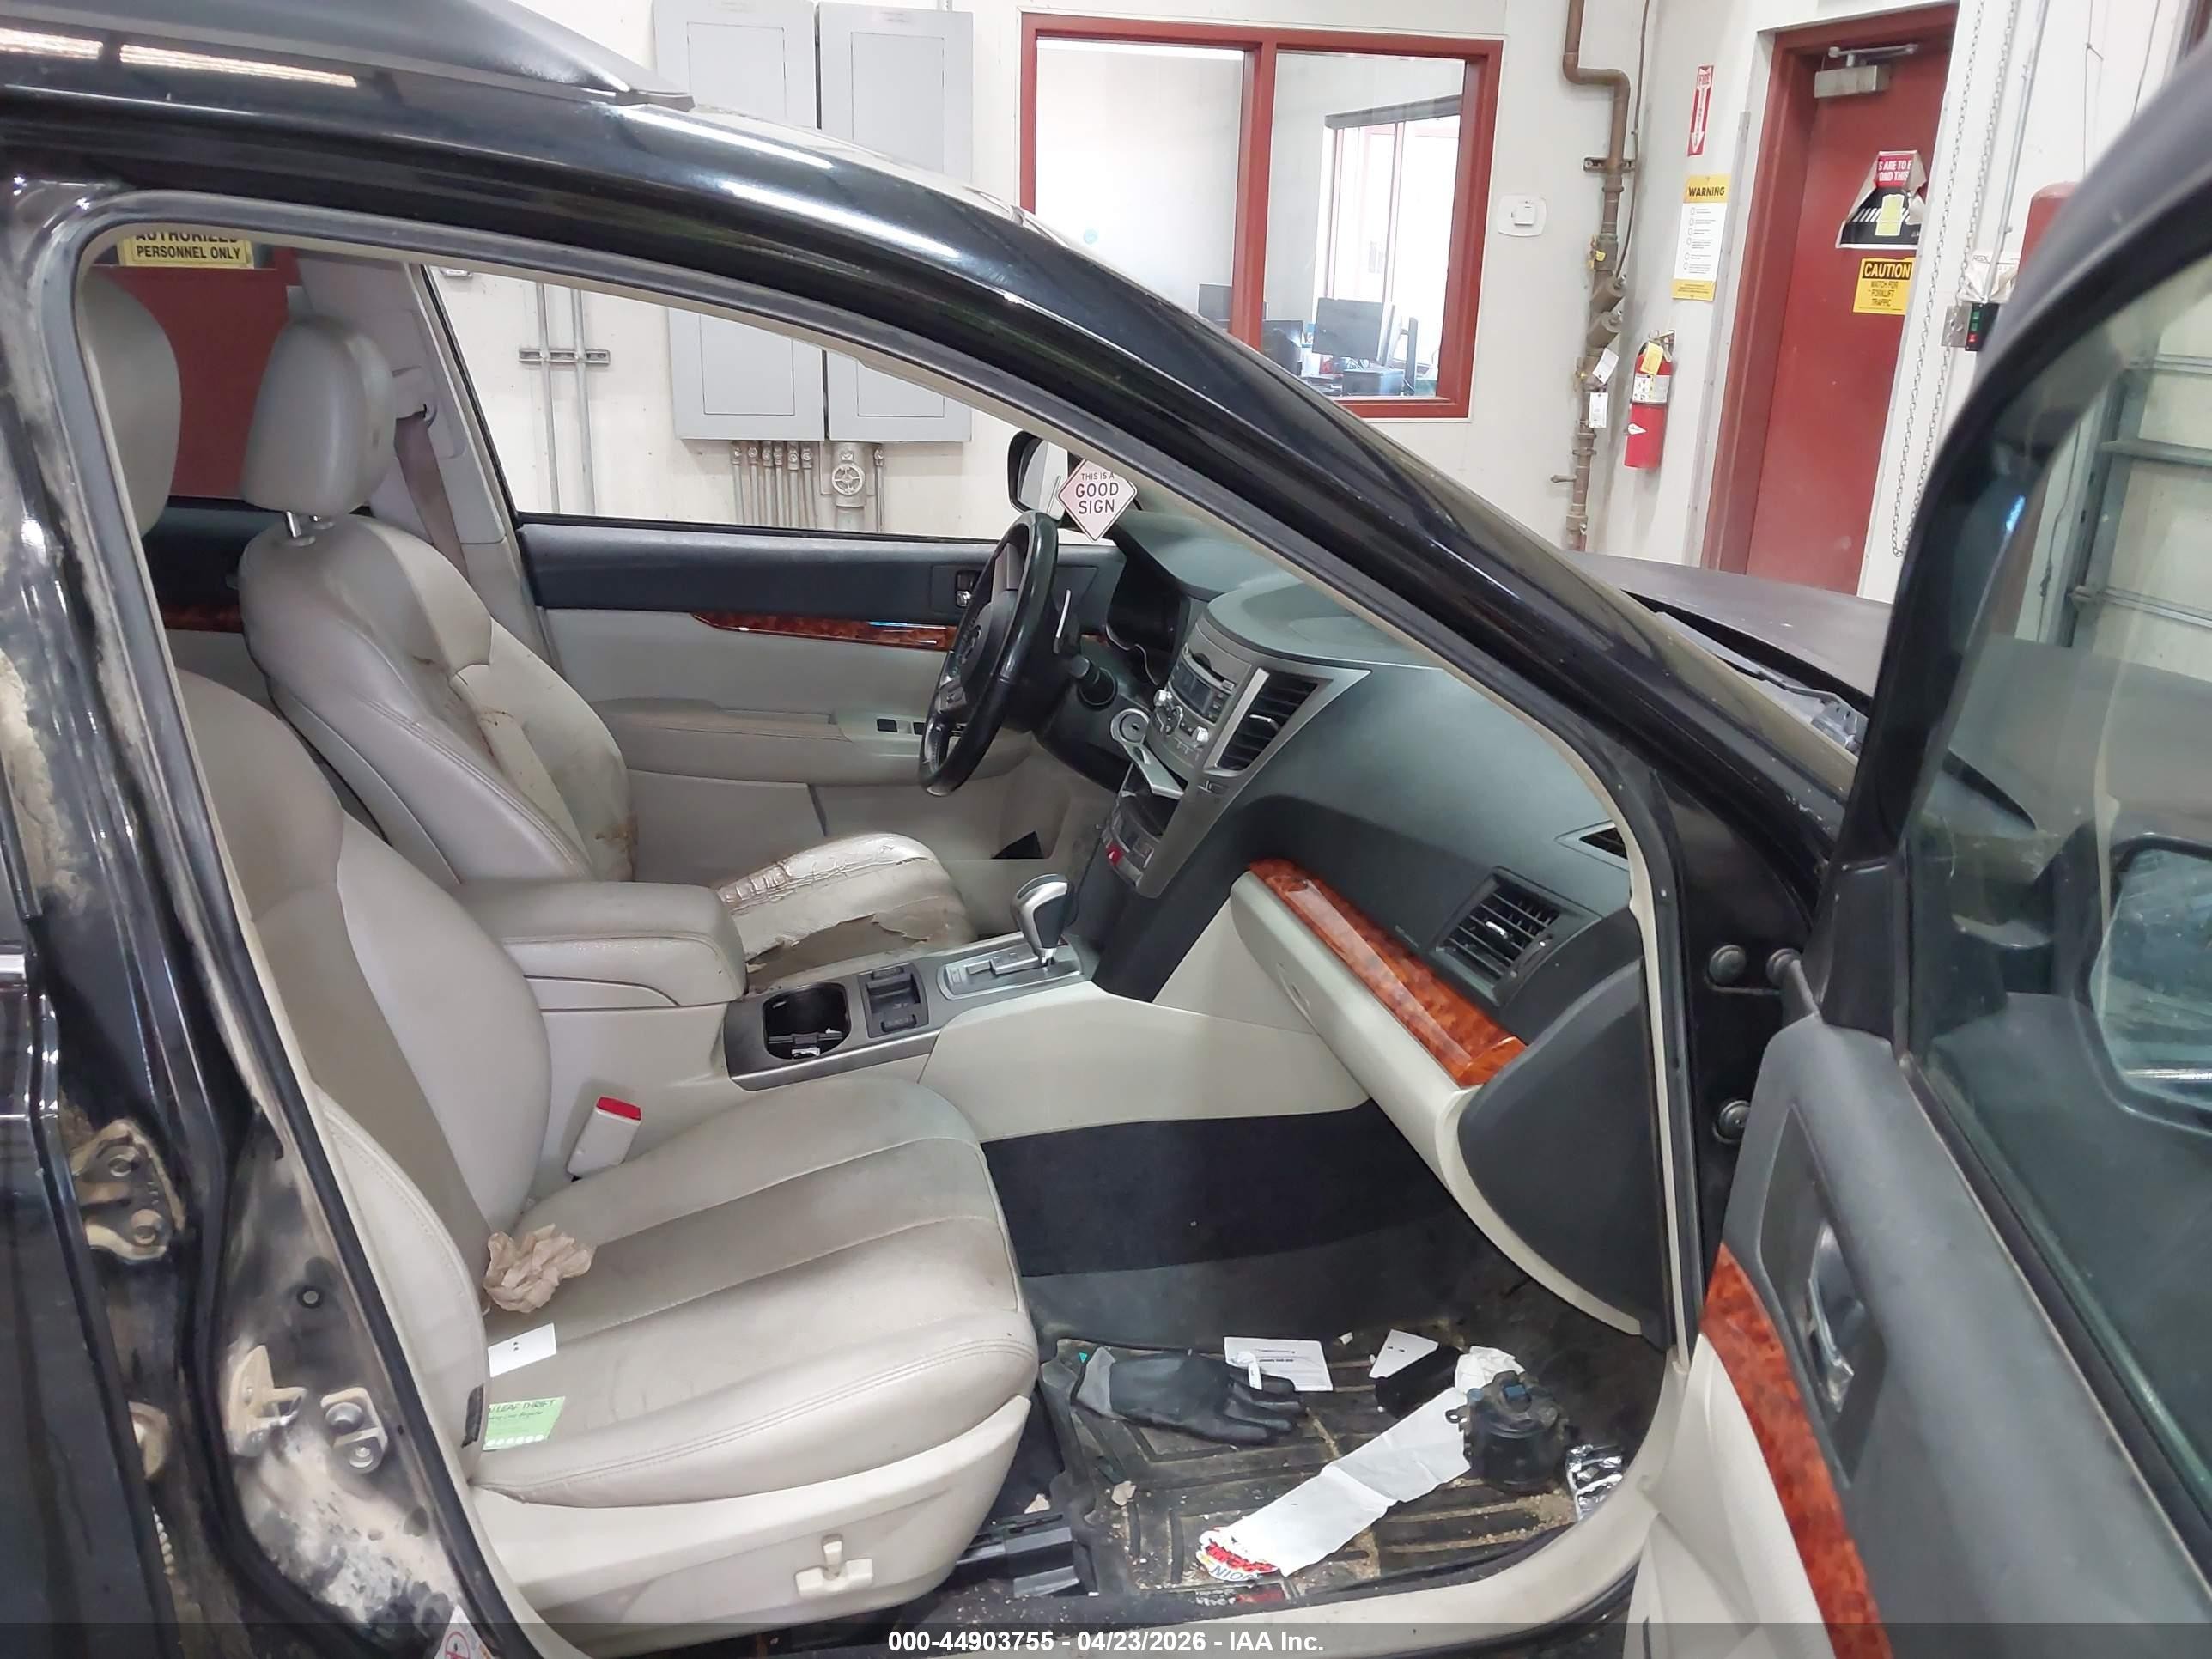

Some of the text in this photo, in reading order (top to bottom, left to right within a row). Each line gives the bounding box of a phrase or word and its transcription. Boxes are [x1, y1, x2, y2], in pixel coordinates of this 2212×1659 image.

[1898, 160, 1906, 170] TO
[1688, 186, 1725, 197] WARNING
[137, 246, 240, 259] PERSONNEL ONLY
[1864, 263, 1911, 278] CAUTION
[1081, 471, 1115, 481] THIS IS A
[1076, 482, 1119, 498] GOOD
[1079, 499, 1115, 514] SIGN
